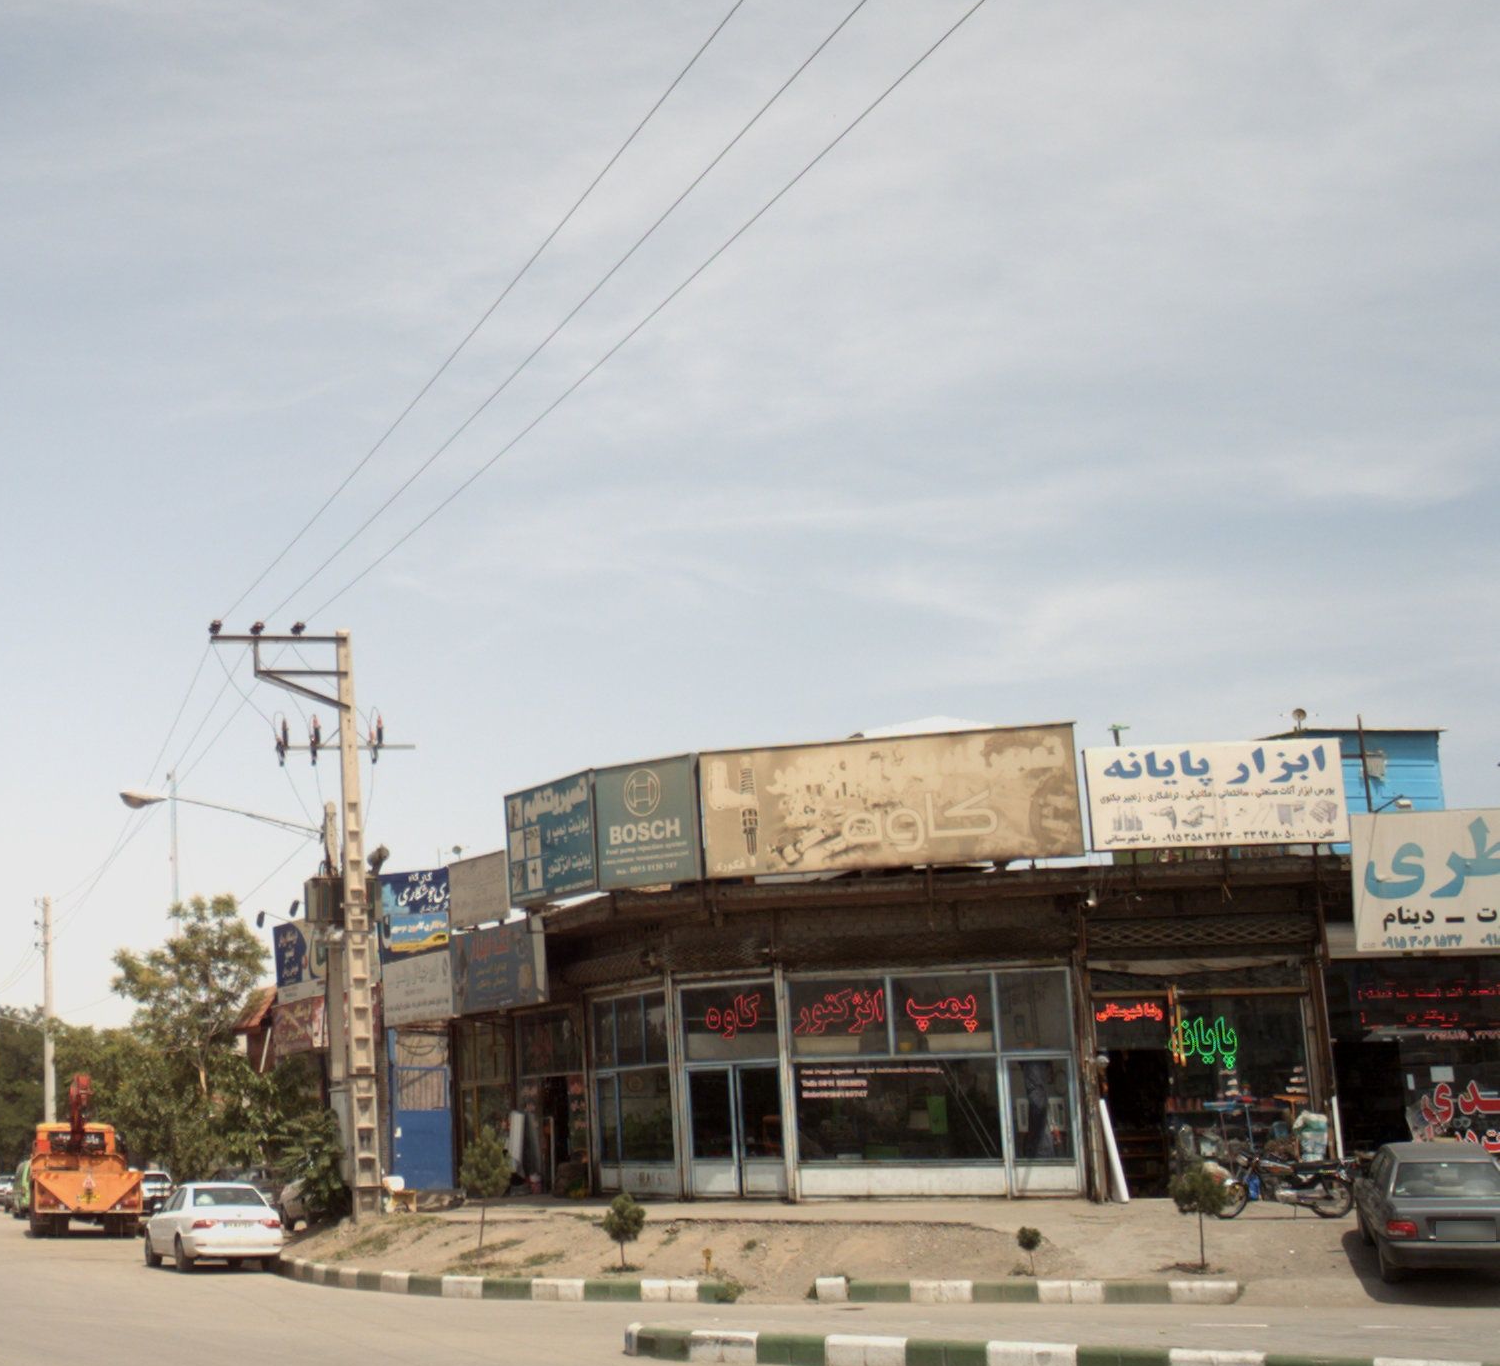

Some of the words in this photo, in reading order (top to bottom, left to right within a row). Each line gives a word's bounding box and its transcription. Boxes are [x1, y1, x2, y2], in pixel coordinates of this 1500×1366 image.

[1103, 749, 1214, 787] پایانه
[1226, 744, 1326, 785] ابزار
[609, 818, 681, 845] BOSCH
[842, 789, 998, 853] کاوه
[1382, 905, 1435, 932] دینام
[705, 992, 761, 1040] کاوه
[794, 987, 885, 1035] انژکتور
[906, 993, 978, 1034] پمپ
